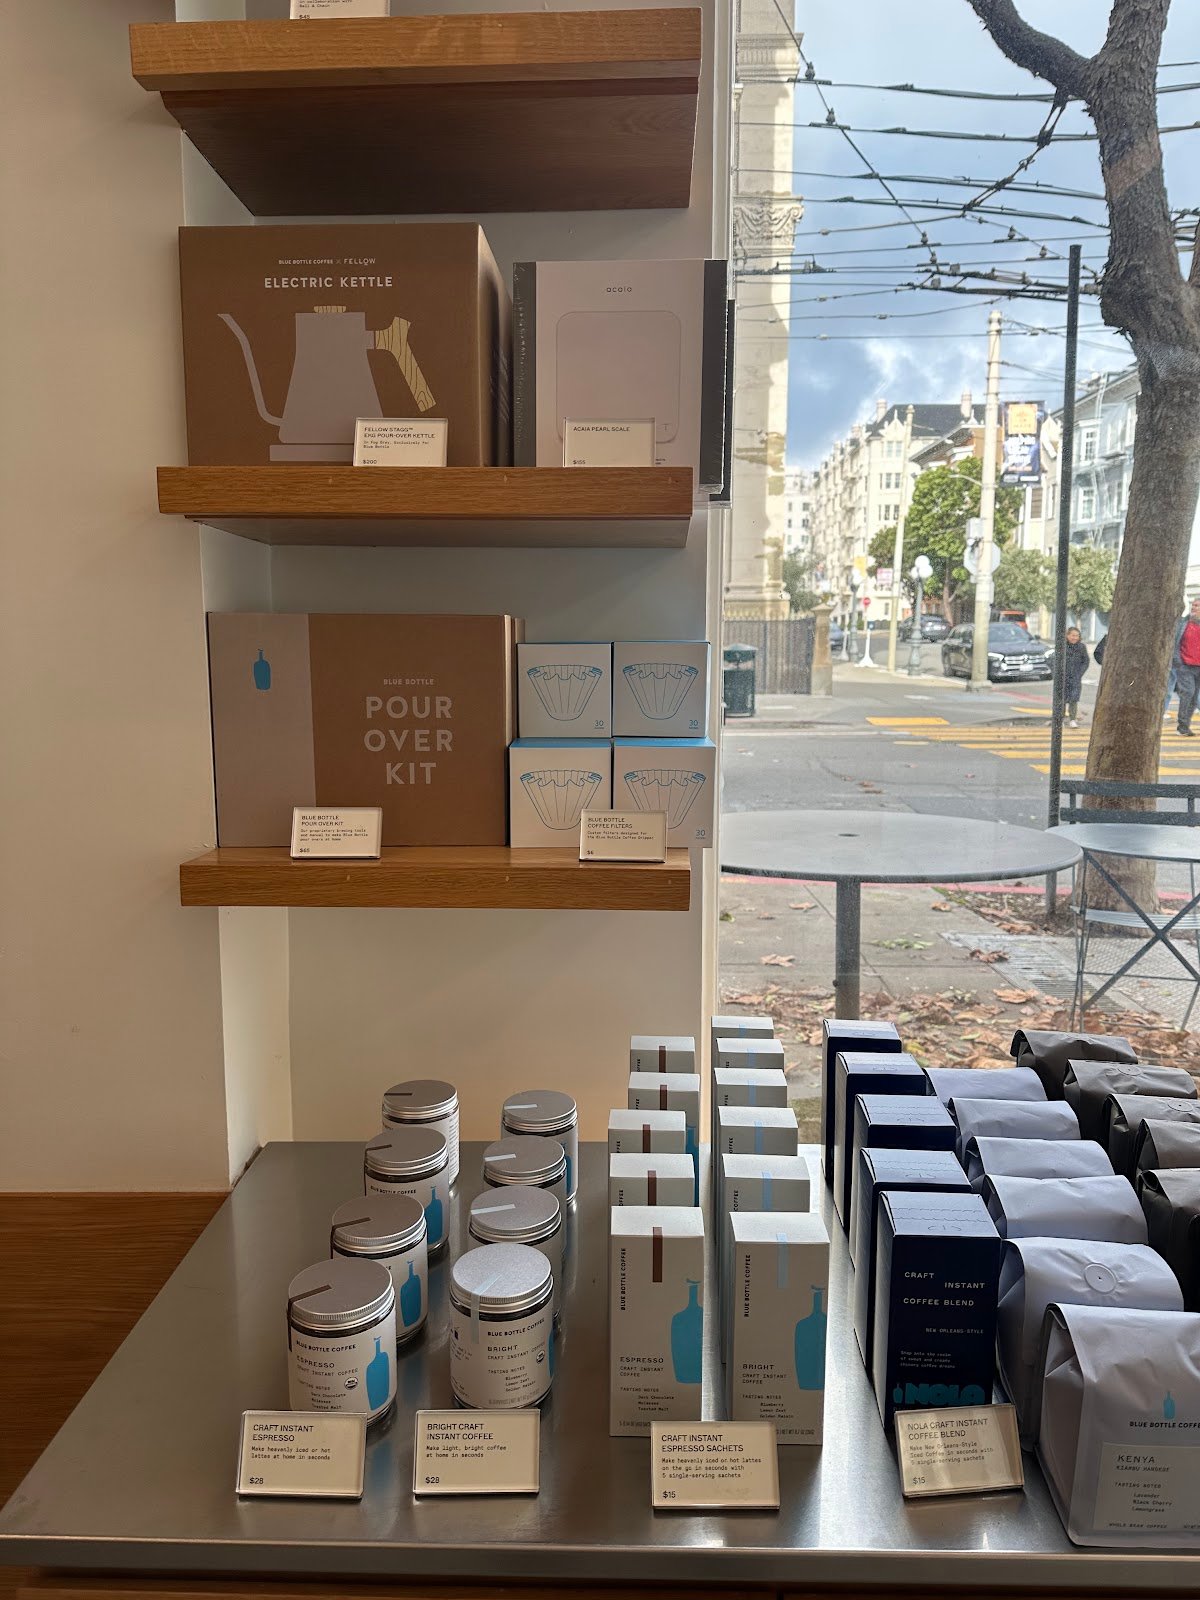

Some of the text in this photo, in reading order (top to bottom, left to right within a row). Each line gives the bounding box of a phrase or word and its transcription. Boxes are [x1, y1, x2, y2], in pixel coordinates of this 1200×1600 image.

[264, 277, 392, 288] ELECTRIC KETTLE
[366, 696, 452, 718] POUR
[364, 729, 452, 751] OVER
[386, 763, 436, 784] KIT
[504, 1328, 525, 1336] BOTTLE
[528, 1318, 544, 1331] COFFEE
[296, 1340, 307, 1348] BLUE
[332, 1344, 356, 1352] COFFEE
[507, 1351, 528, 1359] INSTANT
[297, 1356, 335, 1368] ESPRESSO
[338, 1368, 358, 1376] COFFEE
[906, 1383, 985, 1406] NOLA
[956, 1419, 988, 1427] INSTANT
[908, 1430, 966, 1440] COFFEE BLEND
[1117, 1455, 1155, 1463] KENYA
[913, 1477, 926, 1485] $15
[663, 1491, 676, 1499] $15
